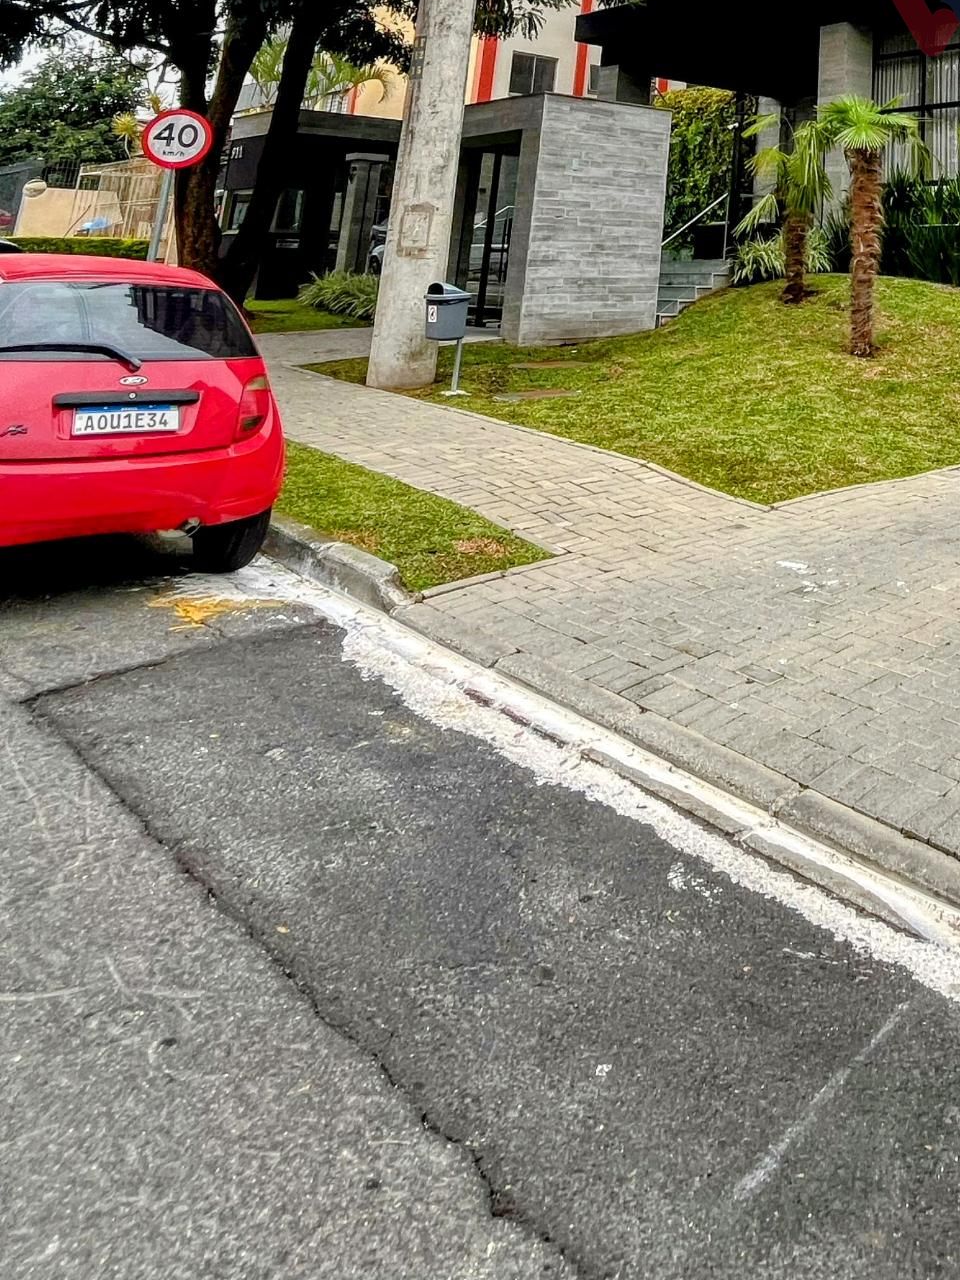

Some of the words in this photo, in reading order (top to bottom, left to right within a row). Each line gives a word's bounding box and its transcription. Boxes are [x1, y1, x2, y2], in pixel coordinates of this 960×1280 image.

[153, 122, 199, 148] 40
[162, 150, 186, 158] km/h
[84, 412, 169, 431] AOU1E34
